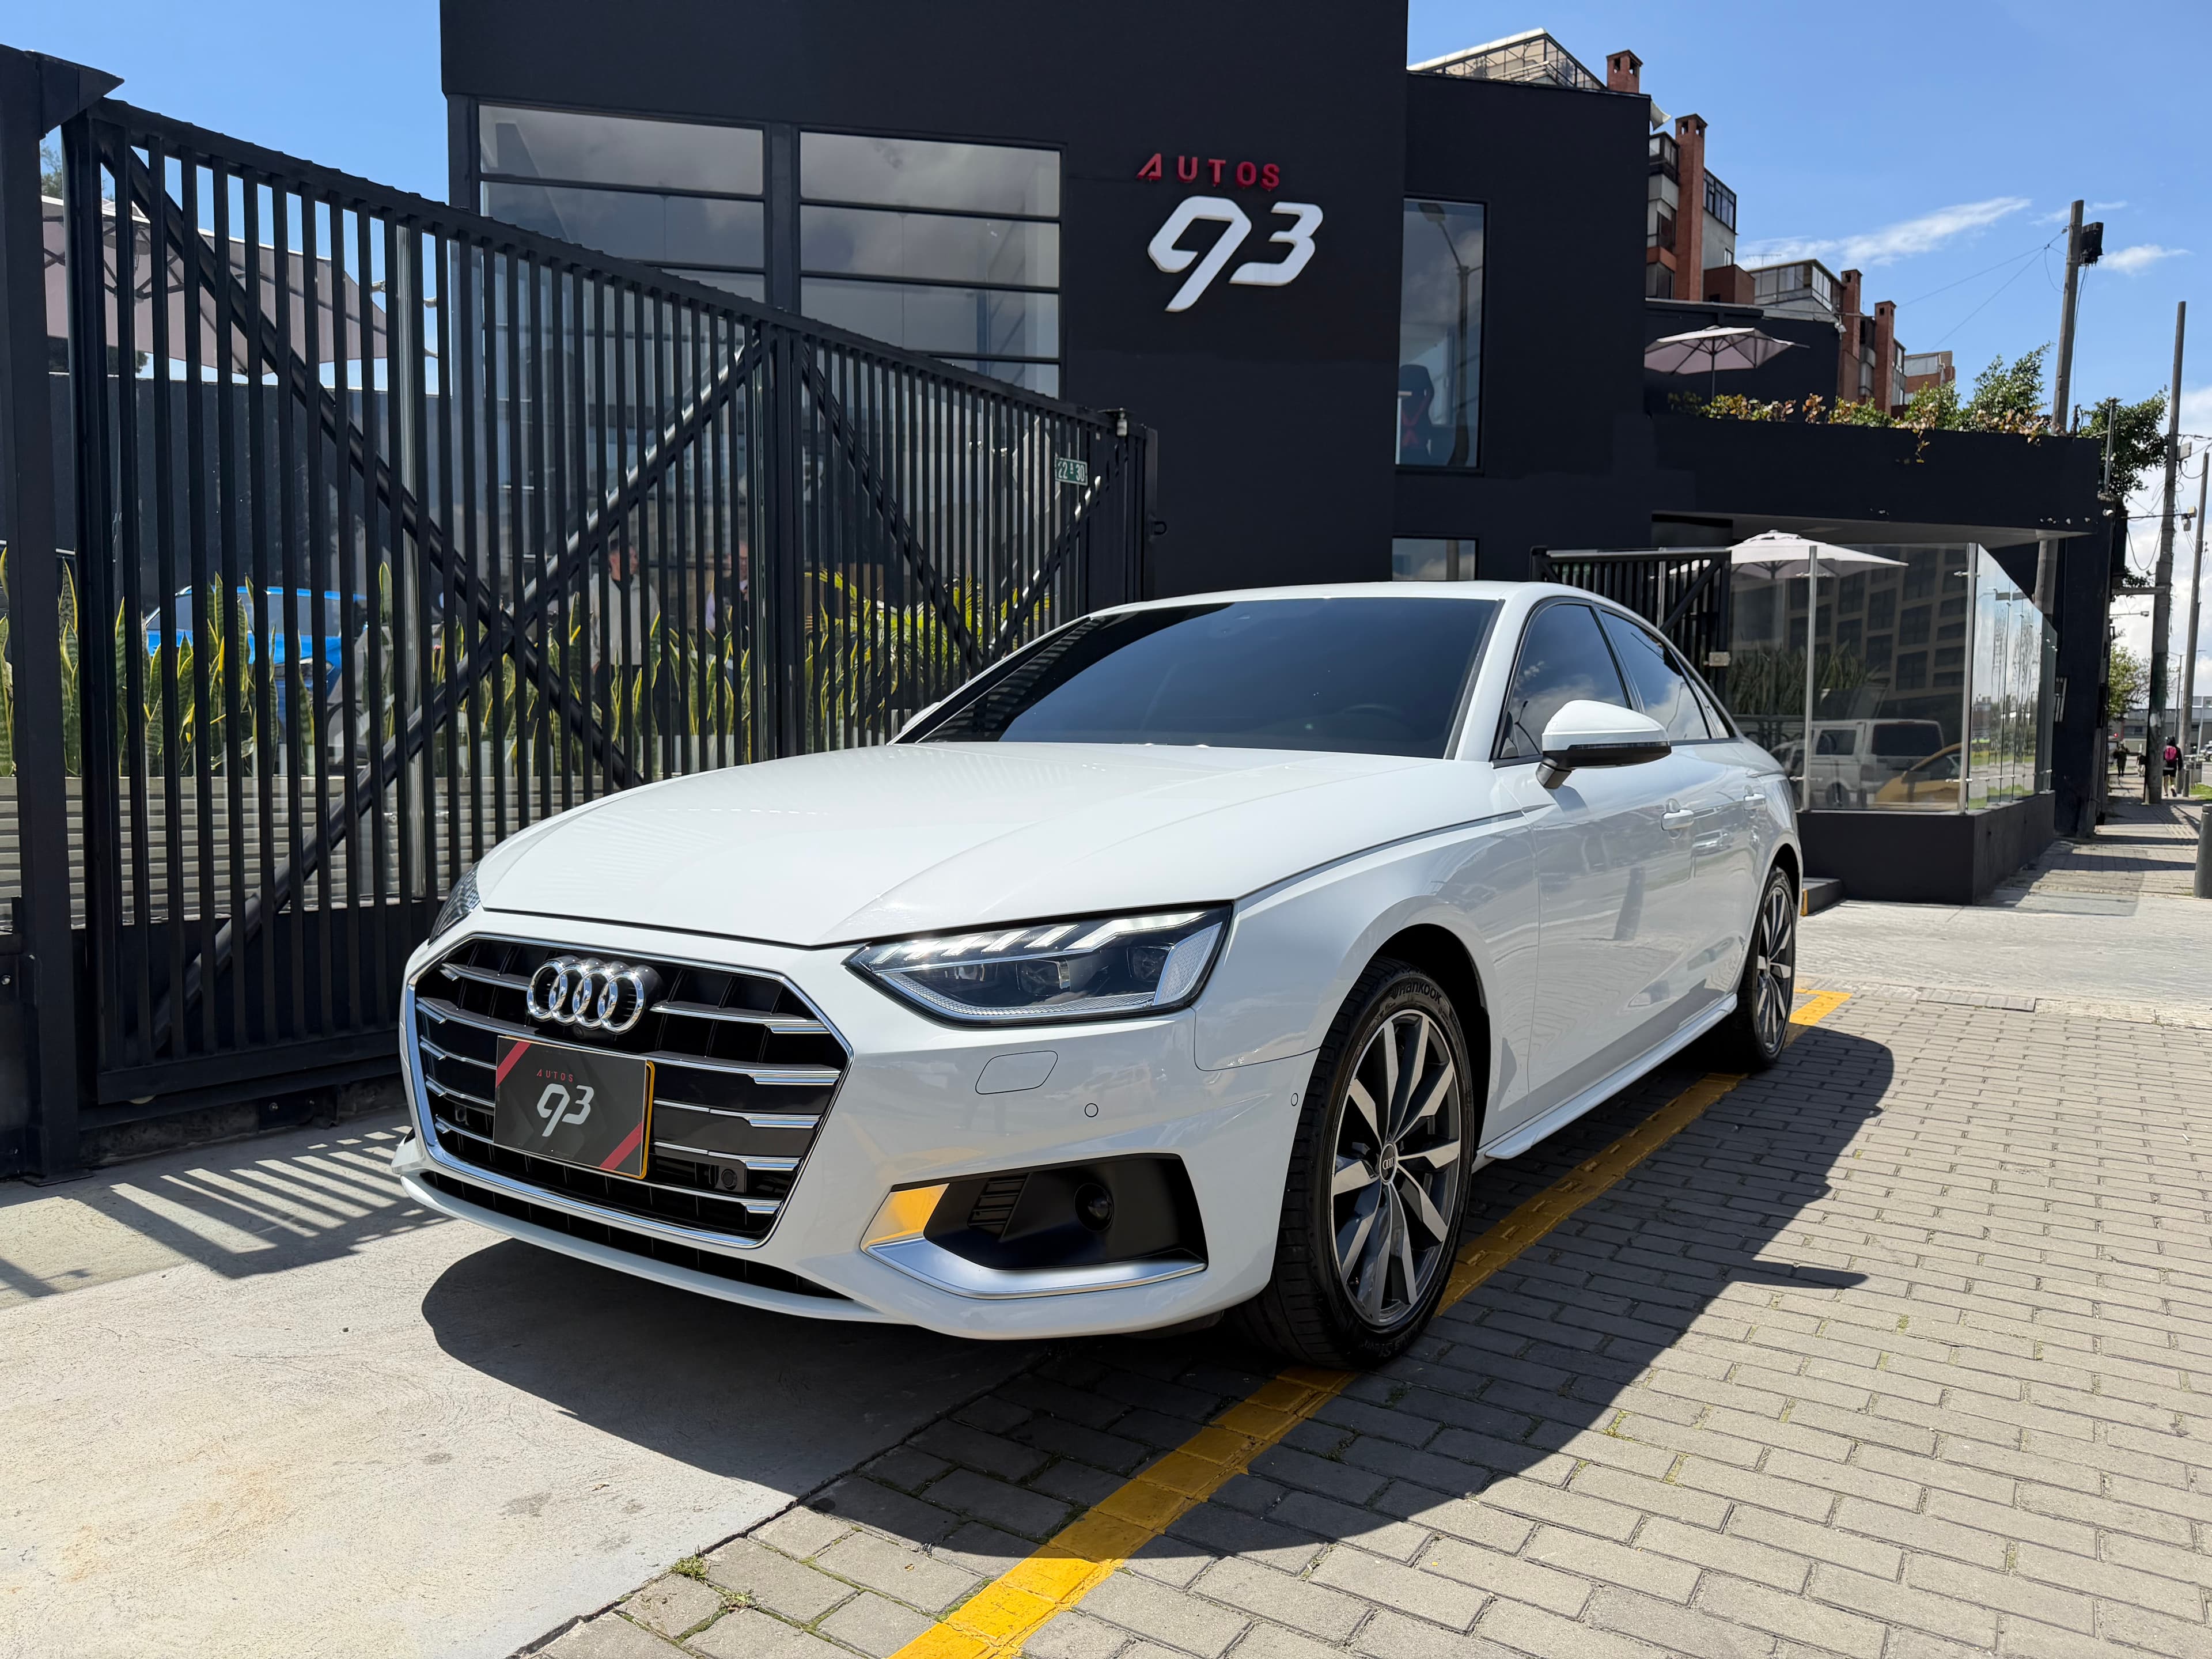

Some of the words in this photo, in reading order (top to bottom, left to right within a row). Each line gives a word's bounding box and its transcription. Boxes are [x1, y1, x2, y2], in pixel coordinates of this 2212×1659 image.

[1137, 153, 1281, 191] AUTOS
[1147, 195, 1324, 312] 93
[1058, 461, 1068, 479] 22
[1075, 464, 1085, 482] 30
[536, 1069, 574, 1082] AUTOS
[537, 1083, 594, 1137] 93
